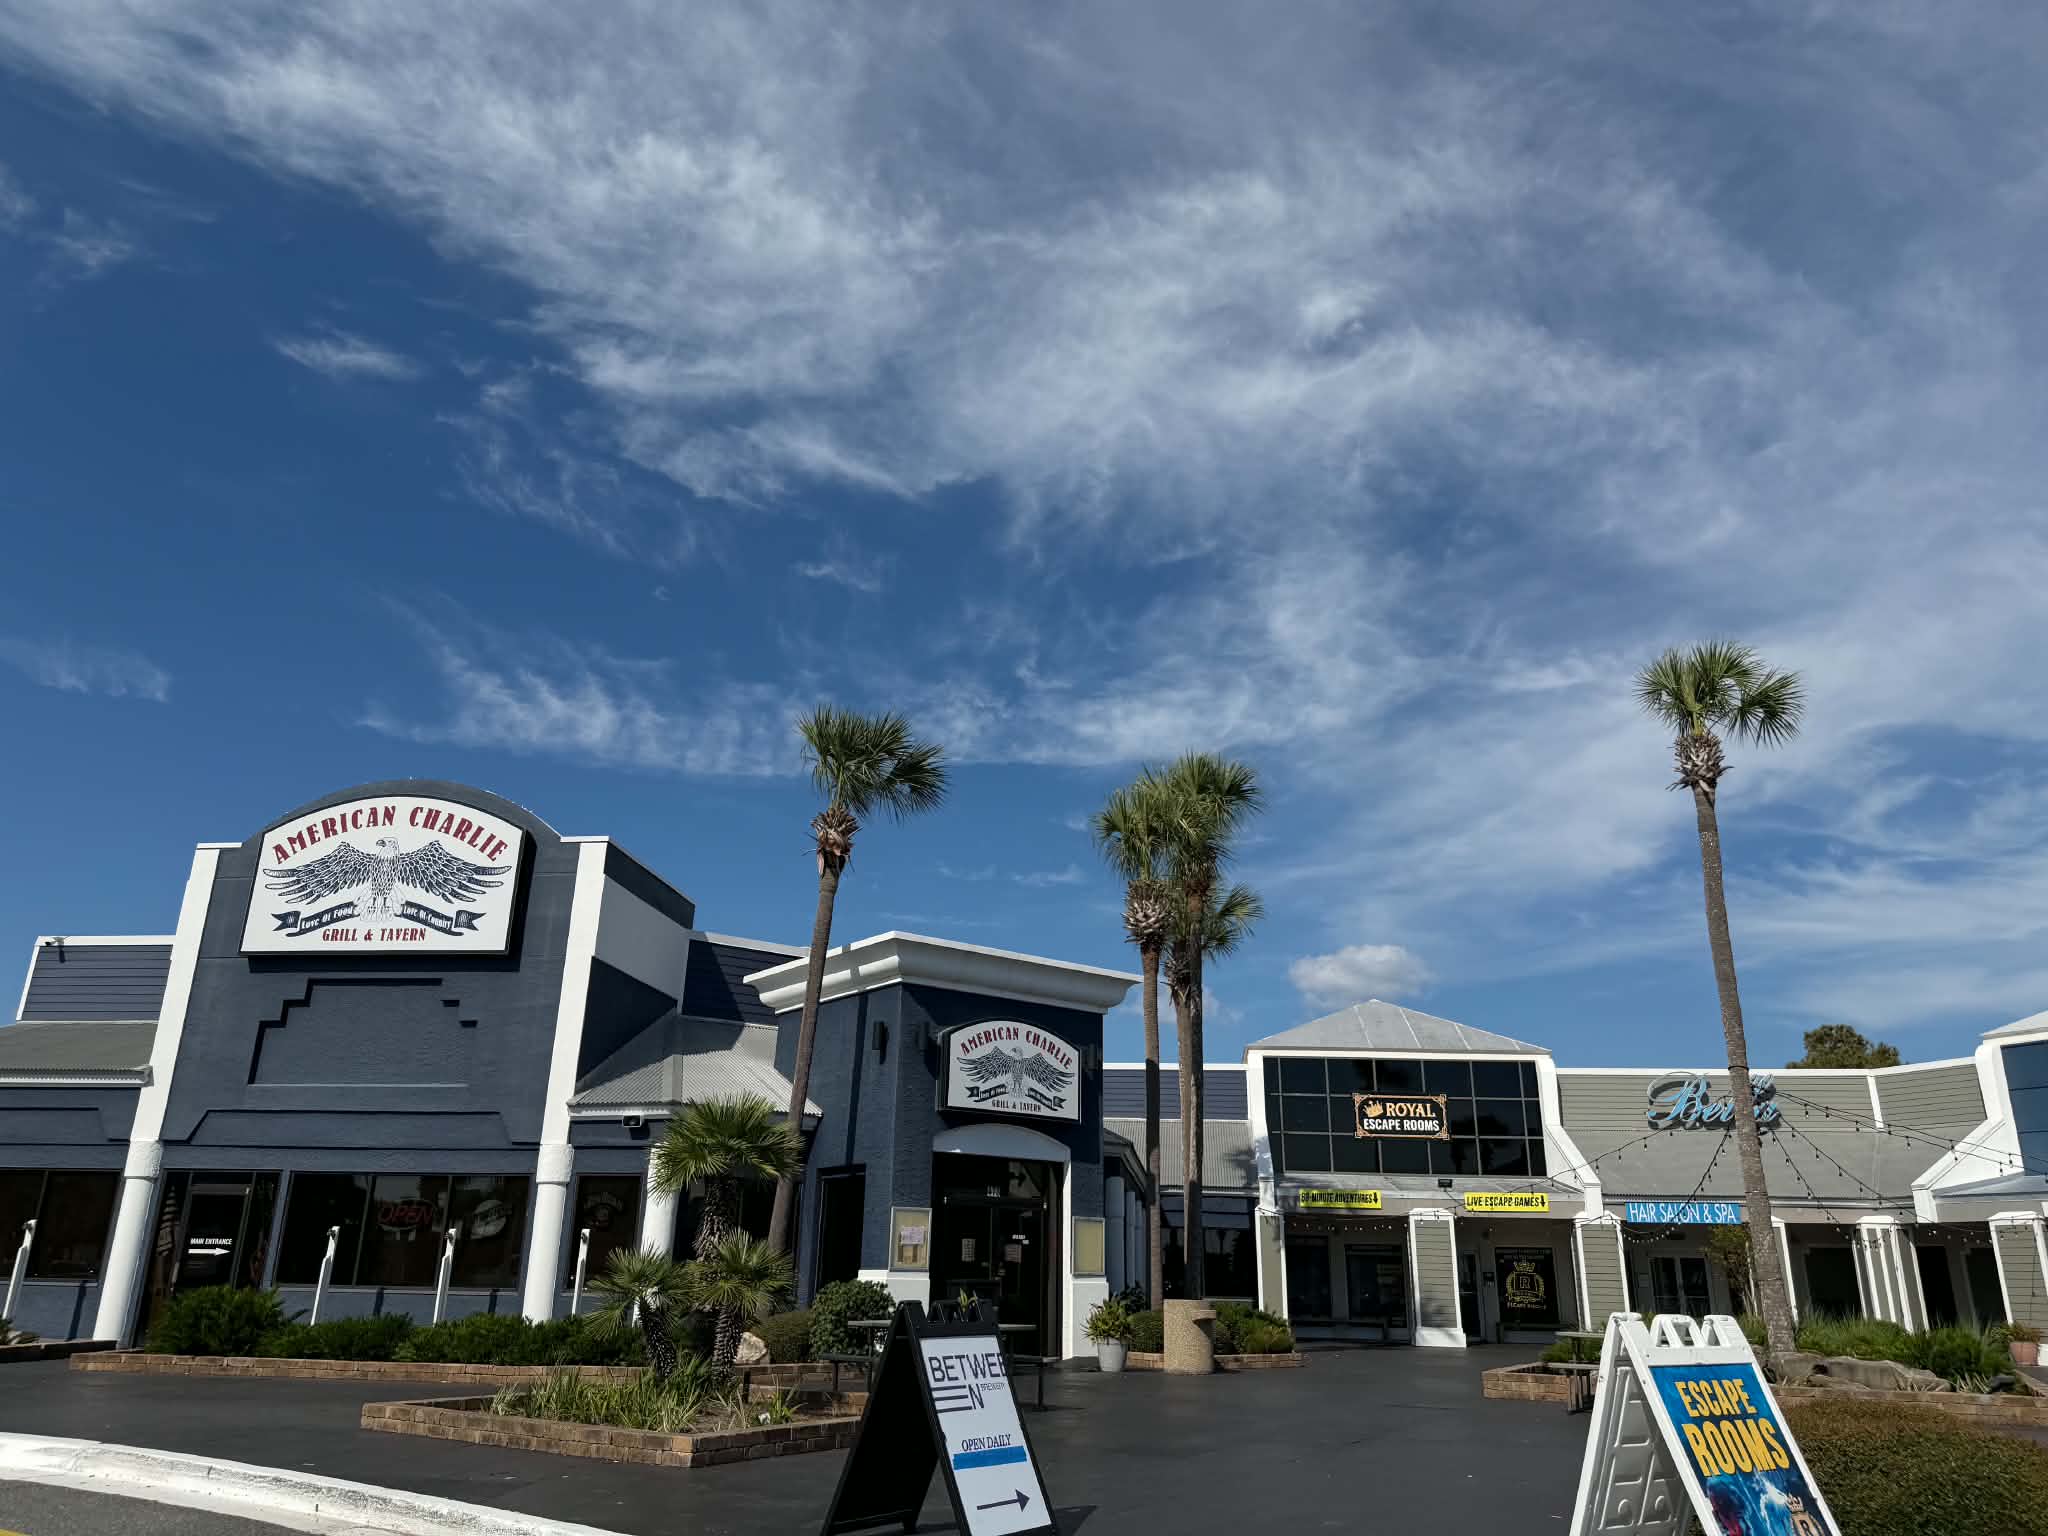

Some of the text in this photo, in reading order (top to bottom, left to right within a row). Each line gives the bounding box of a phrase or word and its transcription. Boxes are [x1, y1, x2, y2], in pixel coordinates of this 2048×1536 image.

[272, 806, 508, 864] AMERICAN CHARLIE
[322, 927, 426, 942] GRILL & TAVERN
[960, 1026, 1073, 1070] AMERICAN CHARLIE
[991, 1099, 1009, 1109] GRILL
[1020, 1101, 1041, 1112] TAVERN
[1385, 1102, 1436, 1117] ROYAL
[1363, 1118, 1440, 1132] ESCAPE ROOMS
[1334, 1191, 1373, 1204] ADVENTURES
[1466, 1196, 1540, 1207] LIVE ESCAPE GAMES
[377, 1204, 433, 1225] OPEN
[1629, 1203, 1737, 1224] HAIR SALON & SPA
[190, 1237, 232, 1245] MAIN ENTRANCE
[1675, 1378, 1757, 1418] ESCAPE
[961, 1434, 1012, 1452] OPEN DAILY
[1681, 1418, 1790, 1477] ROOMS
